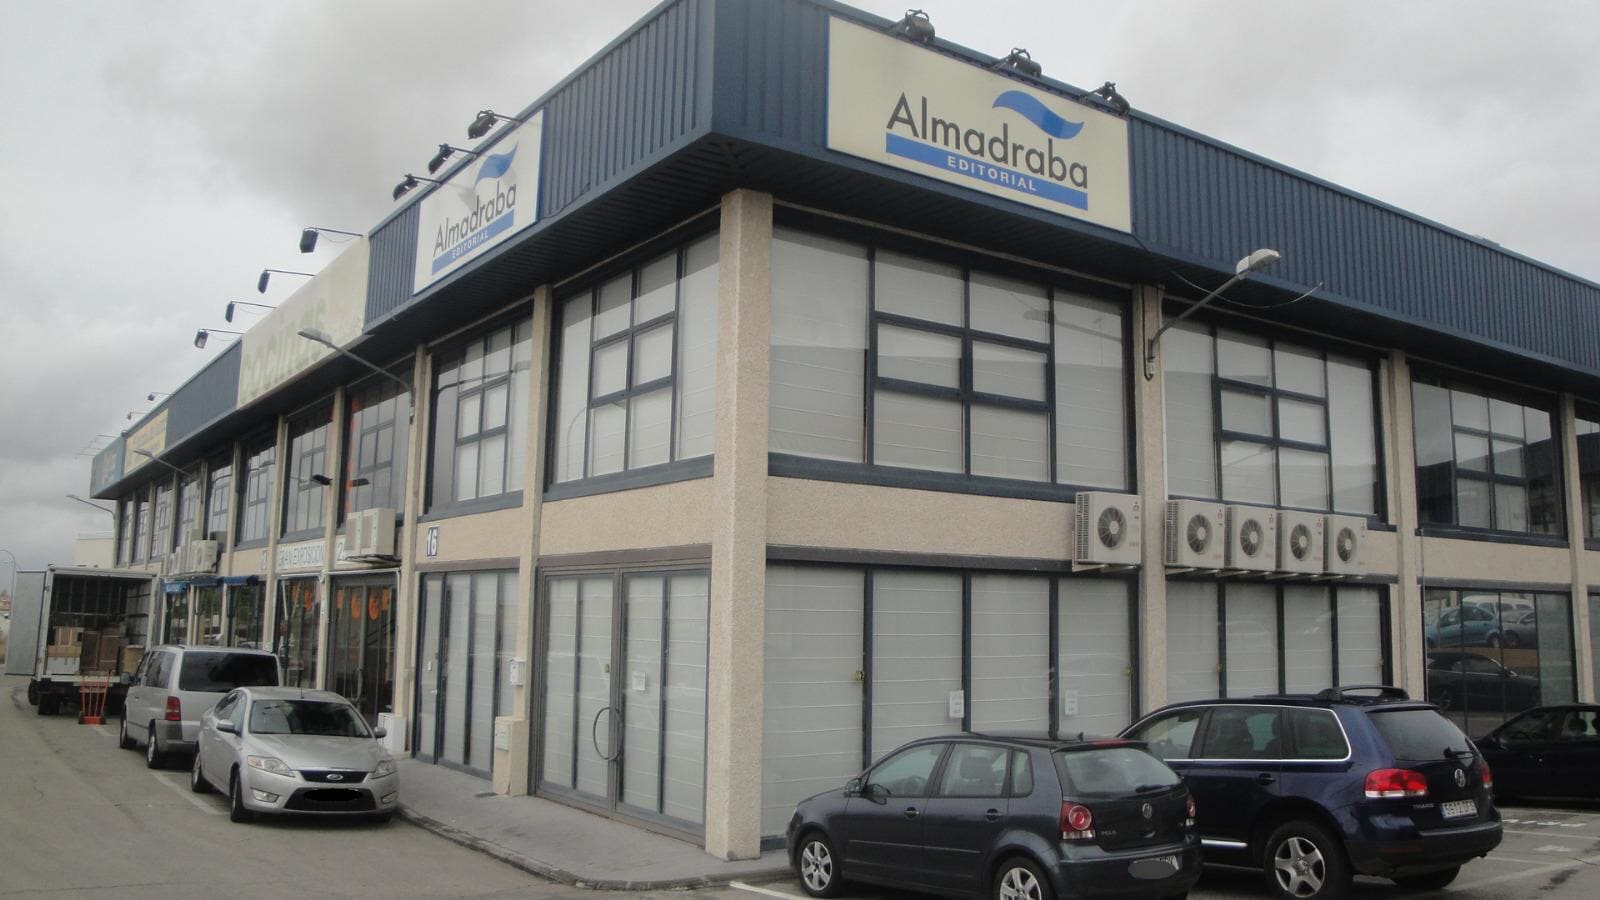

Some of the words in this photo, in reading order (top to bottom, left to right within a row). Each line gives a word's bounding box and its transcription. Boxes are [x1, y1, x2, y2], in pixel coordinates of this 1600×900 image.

[886, 92, 1088, 189] Almadraba
[947, 156, 1036, 191] EDITORIAL
[433, 181, 516, 257] Almadraba
[451, 230, 489, 259] EDITORIAL
[427, 528, 438, 556] 16
